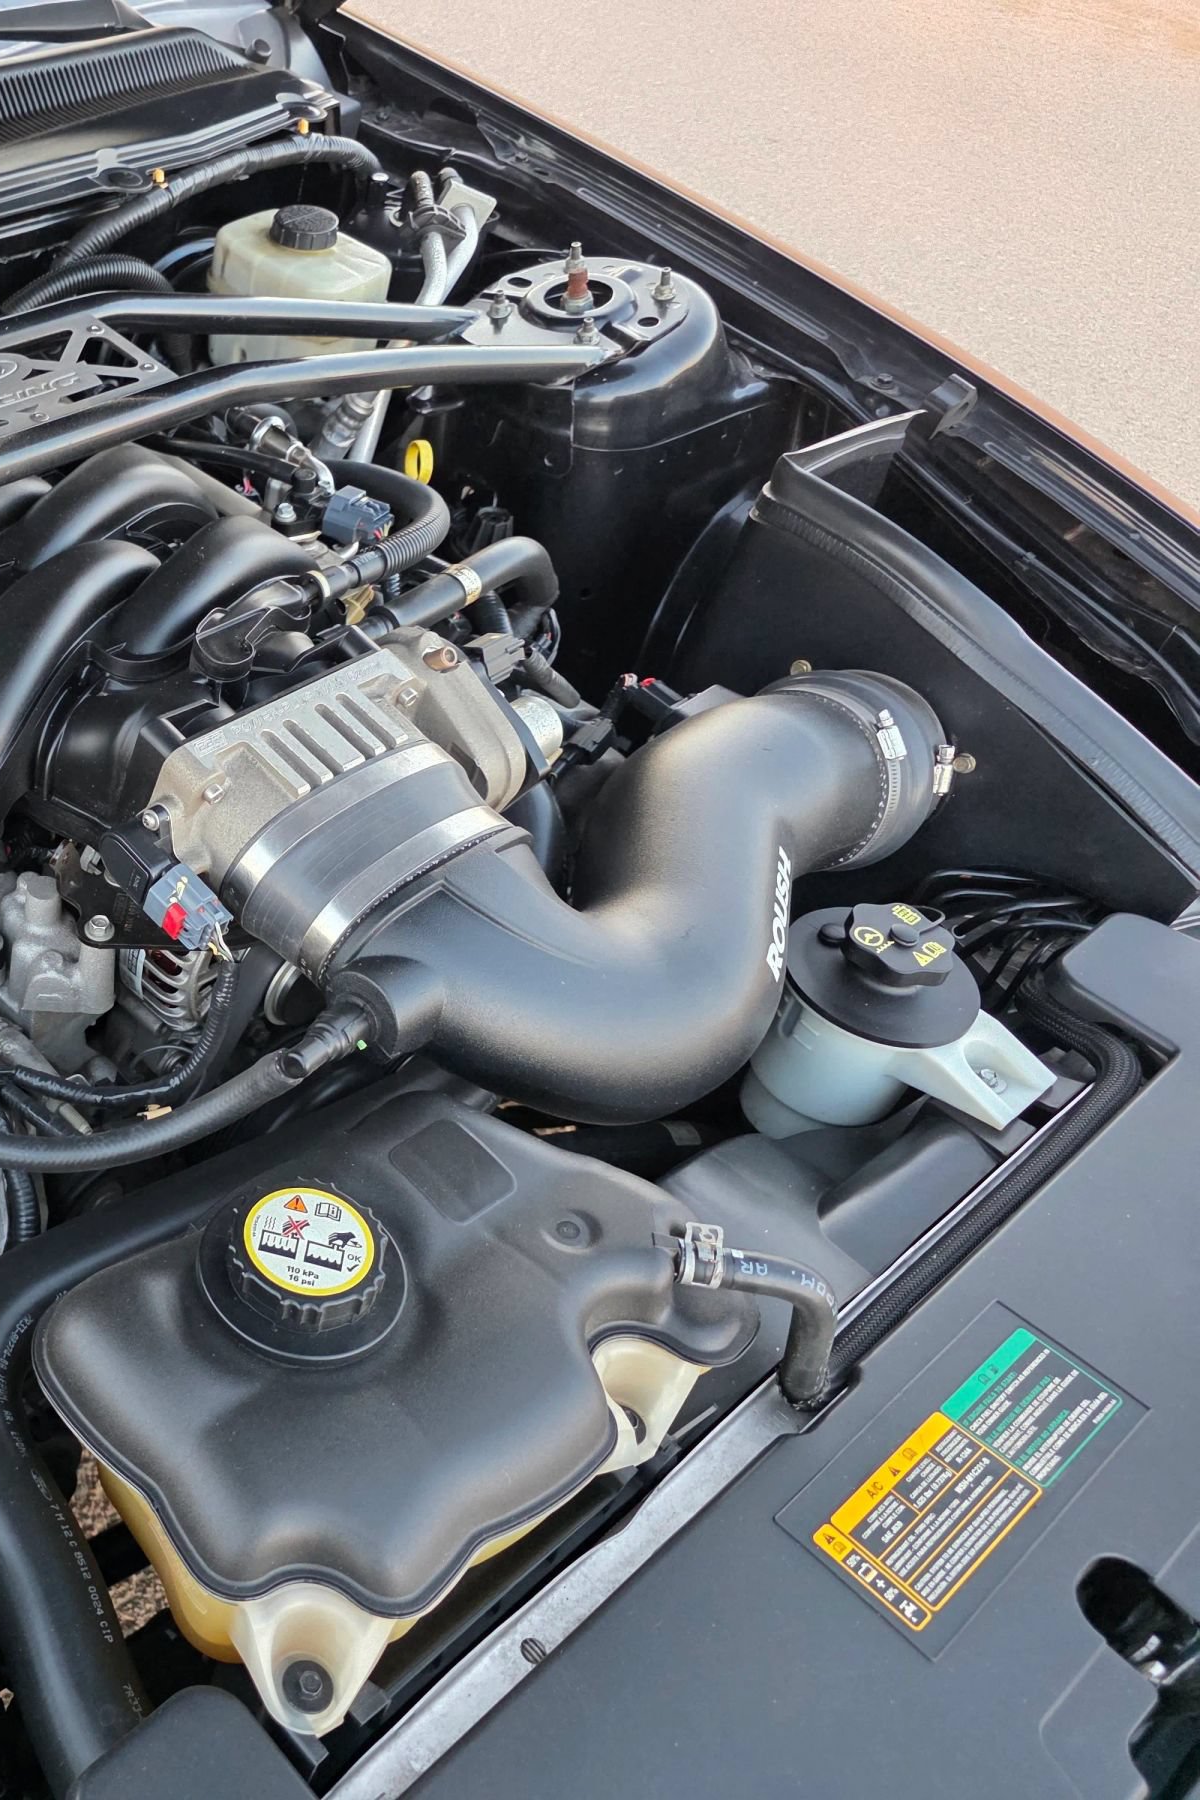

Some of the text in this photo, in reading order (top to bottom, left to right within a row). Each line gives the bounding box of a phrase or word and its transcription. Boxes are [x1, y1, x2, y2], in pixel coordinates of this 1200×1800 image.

[766, 846, 791, 982] ROUSH
[347, 1253, 362, 1263] OK
[287, 1265, 319, 1279] 110 kPa
[289, 1274, 299, 1282] 16
[865, 1480, 883, 1498] A/C
[880, 1529, 894, 1543] SAE
